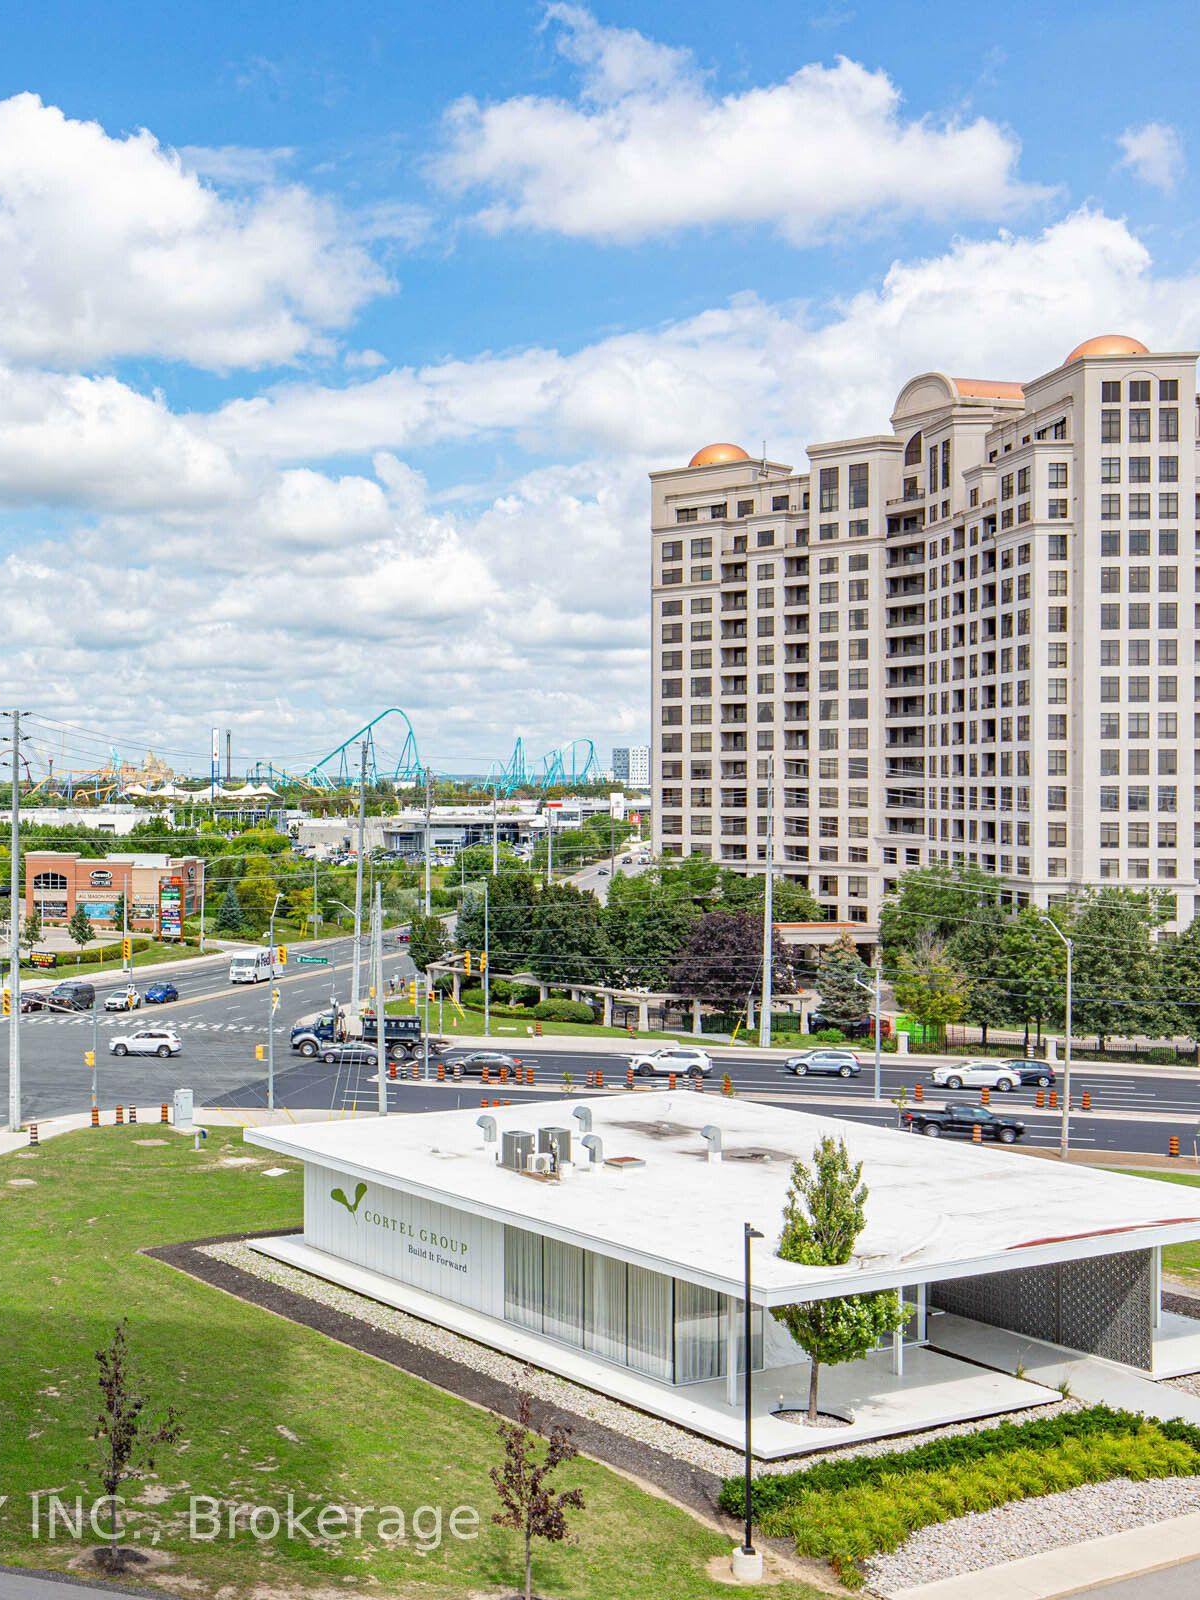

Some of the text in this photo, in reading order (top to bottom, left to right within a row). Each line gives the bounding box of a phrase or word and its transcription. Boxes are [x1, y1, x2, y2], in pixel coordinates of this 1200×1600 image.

[364, 1210, 469, 1256] CORTEL GROUP
[408, 1244, 427, 1260] Build
[436, 1253, 468, 1274] Forward
